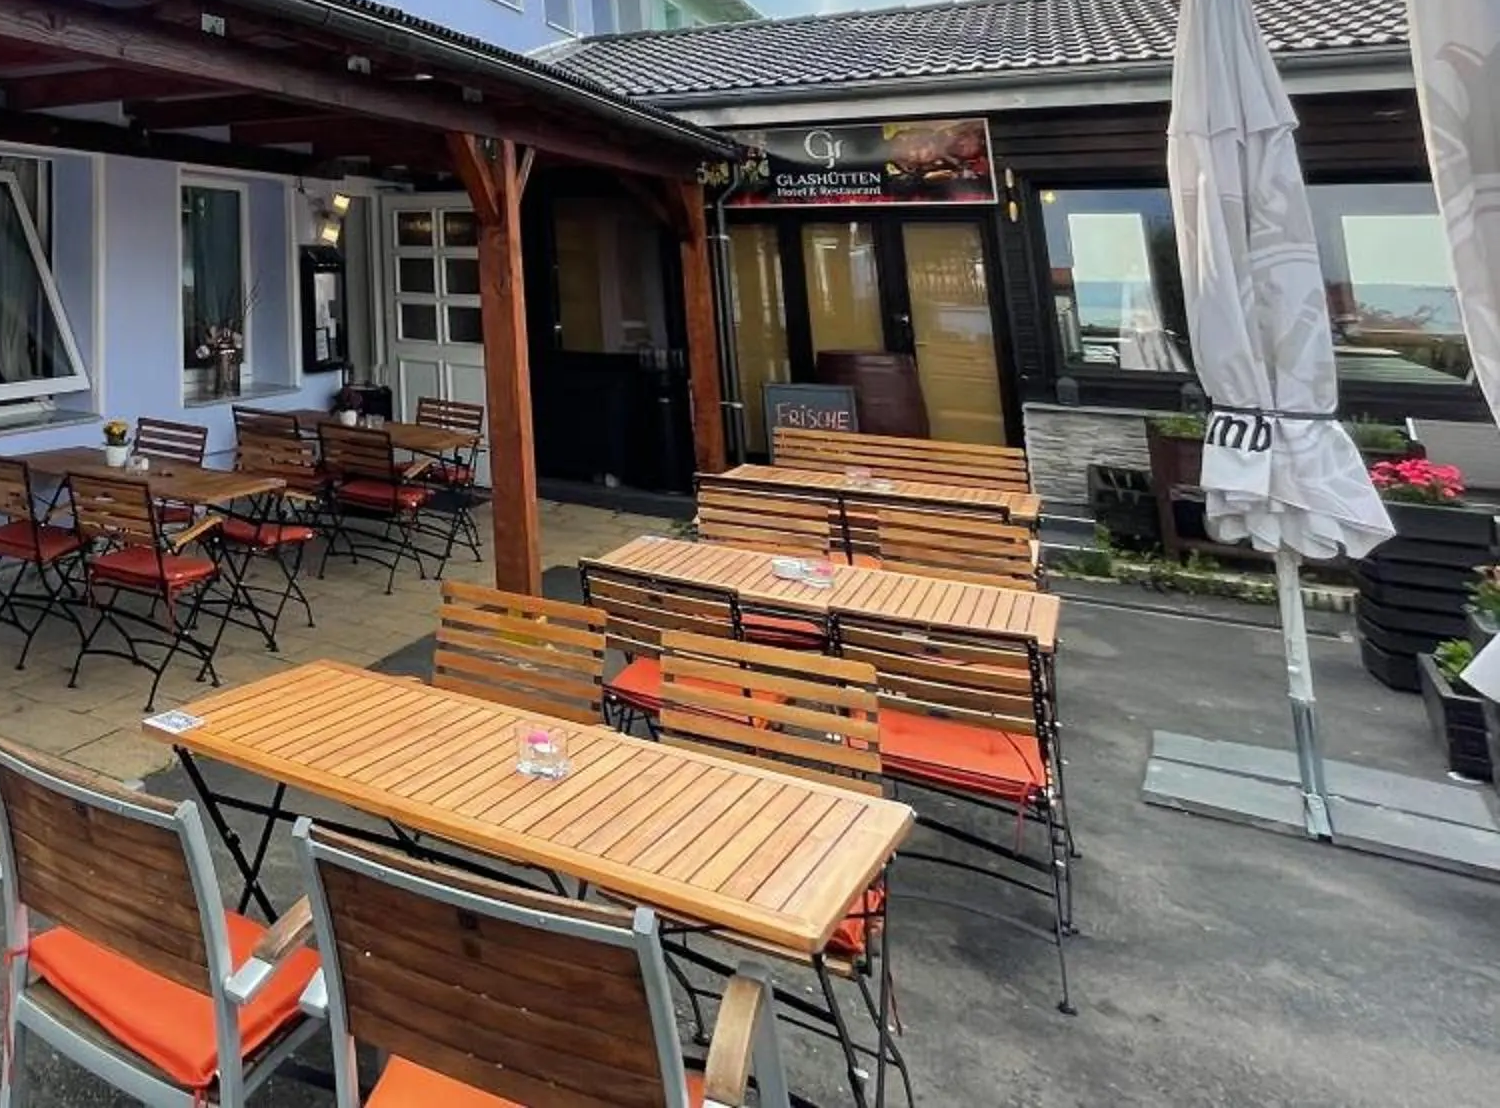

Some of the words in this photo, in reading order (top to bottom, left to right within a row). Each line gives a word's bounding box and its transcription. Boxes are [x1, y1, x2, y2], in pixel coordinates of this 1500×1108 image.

[776, 171, 881, 187] GLASHÜTTEN
[777, 186, 807, 197] Hotel
[819, 185, 882, 196] Restaurant
